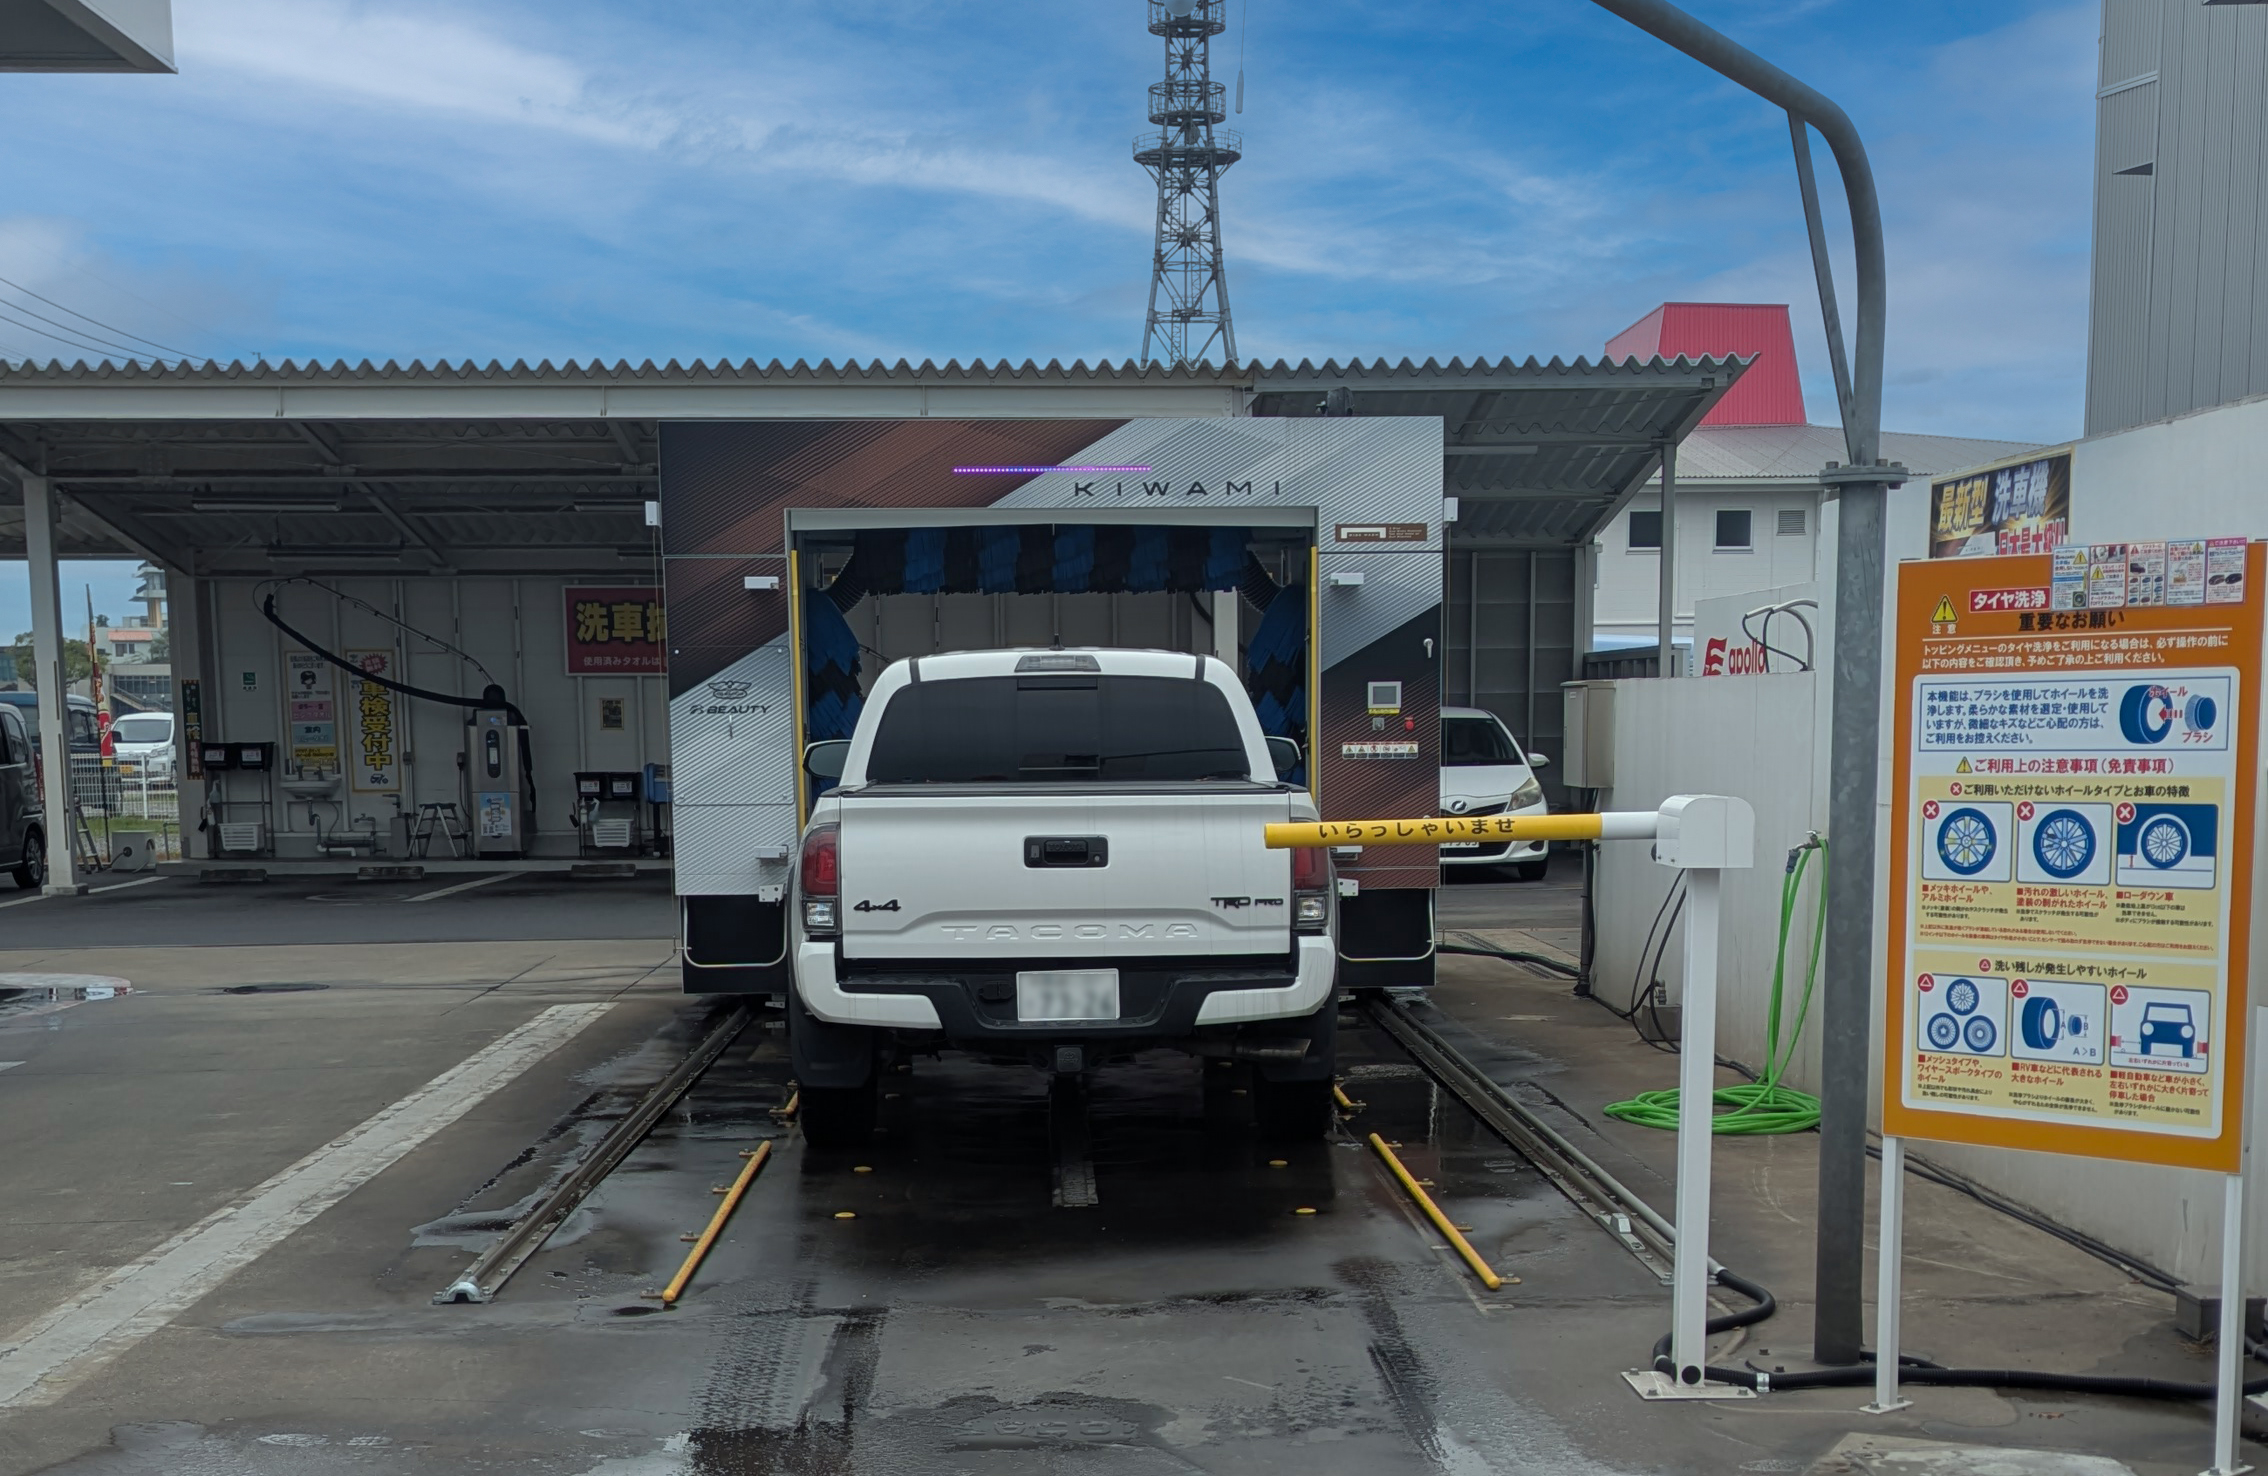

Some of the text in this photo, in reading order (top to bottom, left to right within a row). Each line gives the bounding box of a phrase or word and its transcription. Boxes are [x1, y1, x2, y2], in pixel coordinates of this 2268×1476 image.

[1074, 480, 1279, 497] KIWAMI
[1938, 459, 2049, 532] 最新型 洗車機
[1973, 590, 2047, 610] タイヤ洗浄
[2018, 610, 2126, 632] 重要なお願い
[1926, 687, 2109, 702] 本機能は、ブラシを使用してホイールを洗
[1925, 732, 2034, 745] ご利用をお控えください。
[2182, 731, 2213, 743] ブラシ
[1964, 784, 2190, 798] ご利用いただけないホイールタイプとお車の特徴
[1319, 818, 1515, 838] いらっしゃいませ
[1922, 893, 1974, 903] アルミホイール
[2124, 891, 2174, 901] ローダウン車
[941, 923, 1199, 940] TACOMA
[1995, 960, 2147, 979] 洗い残しが発生しやすいホイール
[1917, 1073, 1946, 1083] ホイール
[2011, 1074, 2064, 1086] 大きなホイール
